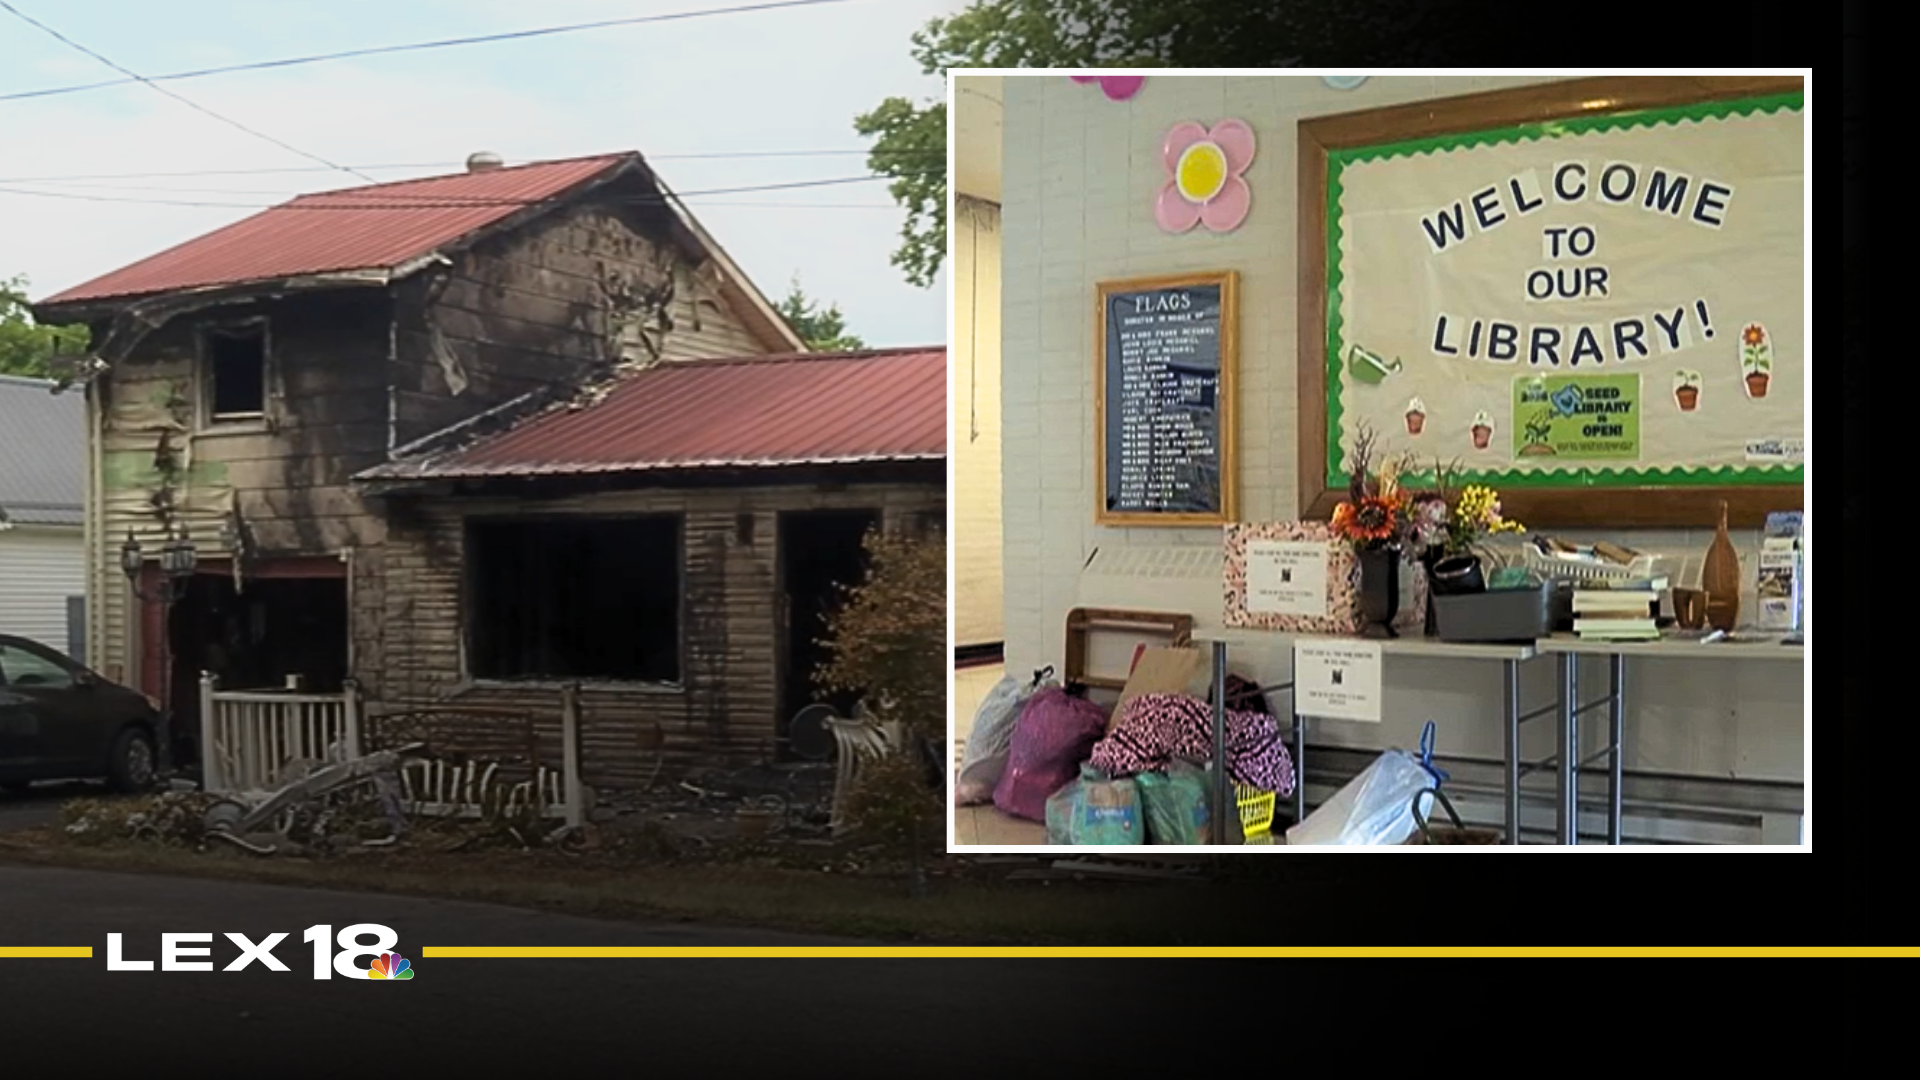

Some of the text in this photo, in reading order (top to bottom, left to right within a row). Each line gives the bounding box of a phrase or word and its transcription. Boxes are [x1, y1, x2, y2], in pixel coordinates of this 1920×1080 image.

[1422, 163, 1731, 249] WELCOME
[1544, 226, 1596, 258] TO
[1526, 266, 1609, 299] OUR
[1135, 291, 1191, 313] FLAGS
[1434, 300, 1715, 366] LIBRARY!
[1585, 387, 1620, 399] SEED
[1574, 401, 1631, 414] LIBRARY
[1582, 424, 1623, 437] OPEN!
